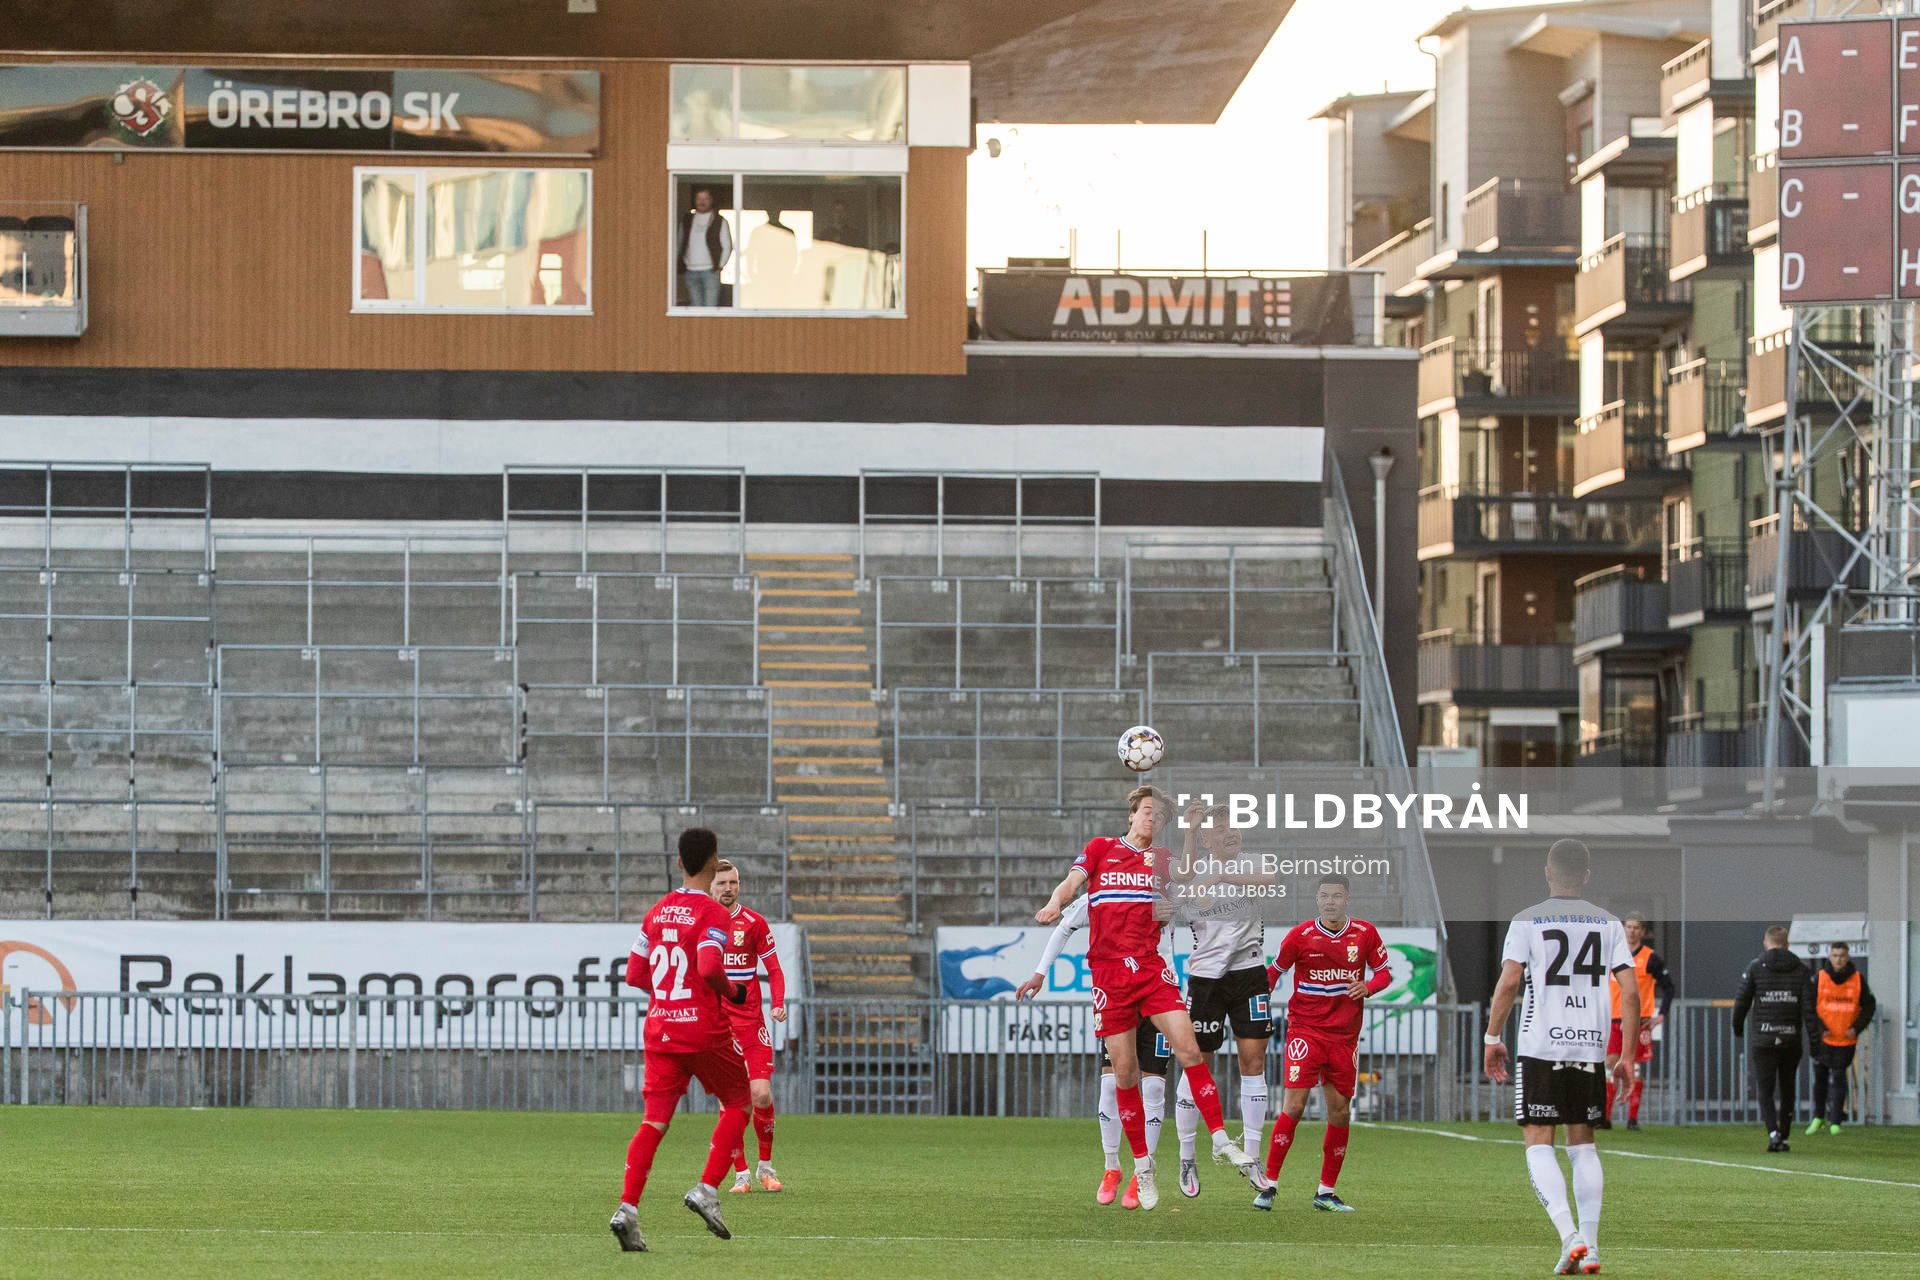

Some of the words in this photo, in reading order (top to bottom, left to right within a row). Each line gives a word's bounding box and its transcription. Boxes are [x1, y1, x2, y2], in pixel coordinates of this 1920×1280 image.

[1780, 36, 1805, 75] A
[1899, 31, 1920, 69] E
[208, 81, 391, 130] ÖREBRO
[403, 92, 460, 131] SK
[1900, 105, 1919, 143] F
[1781, 109, 1803, 147] B
[1780, 178, 1804, 218] C
[1899, 174, 1920, 213] G
[1781, 252, 1805, 290] D
[1900, 248, 1920, 287] H
[1052, 278, 1259, 326] ADMIT
[1100, 872, 1161, 889] SERNEKE
[653, 914, 695, 926] WELLNESS
[661, 905, 692, 915] NORDIC
[1533, 914, 1608, 925] MALMBERGS
[650, 945, 692, 1000] 22
[1542, 929, 1606, 987] 24
[119, 954, 646, 1029] Reklamproff
[1565, 995, 1587, 1008] ALI
[1549, 1027, 1603, 1042] GÖRTZ
